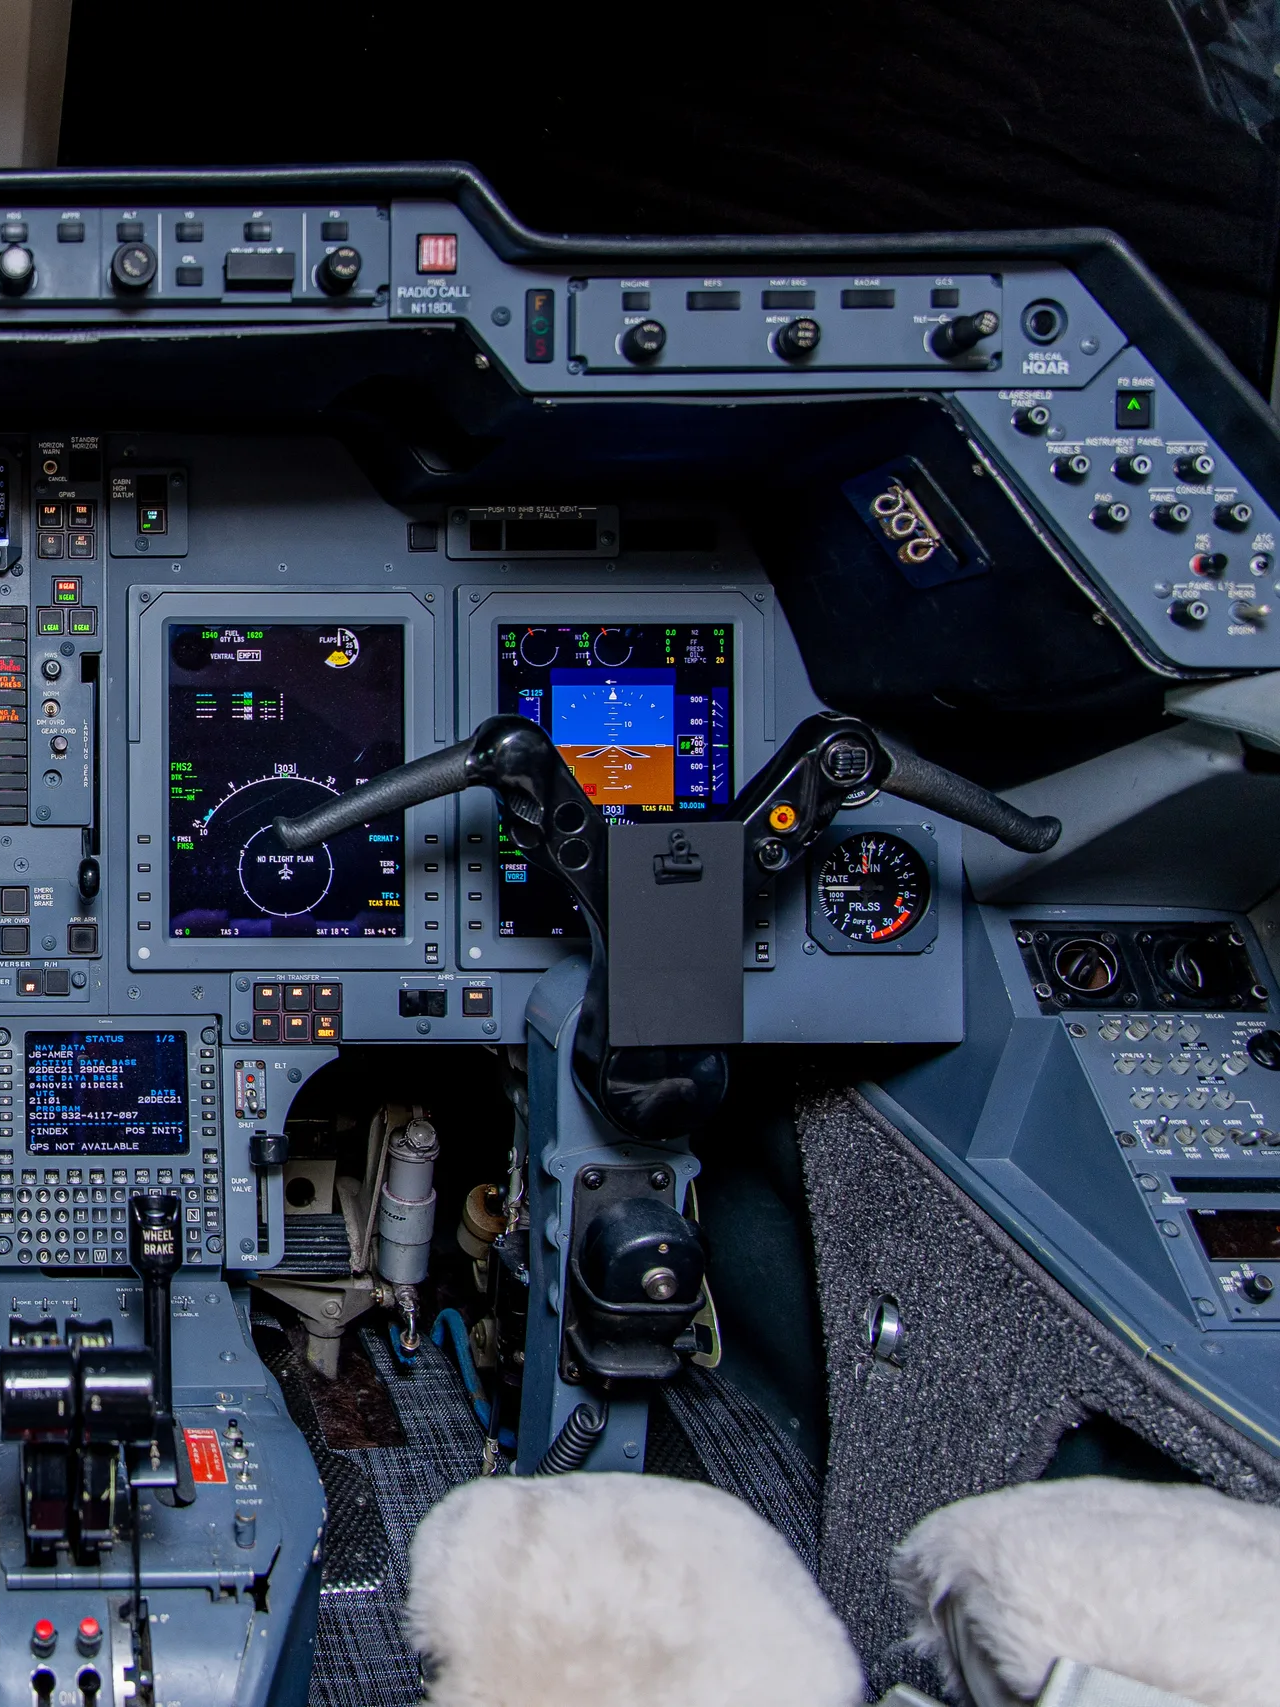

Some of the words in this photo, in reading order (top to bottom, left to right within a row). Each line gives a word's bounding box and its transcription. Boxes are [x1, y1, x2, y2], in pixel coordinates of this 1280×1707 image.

[620, 280, 649, 288] ENGINE
[397, 286, 436, 298] RADIO
[437, 285, 470, 298] CALL
[411, 302, 456, 314] N118DL
[1028, 352, 1062, 361] SELCAL
[1023, 361, 1069, 374] HQAR
[998, 391, 1053, 400] GLARESHIELD
[1085, 437, 1134, 446] INSTRUMENT
[1137, 437, 1164, 446] PANEL
[1048, 446, 1081, 454] PANELS
[1176, 485, 1214, 495] CONSOLE
[202, 631, 218, 639] 1540
[247, 631, 263, 639] 1620
[1227, 626, 1256, 635] STORM
[239, 652, 259, 660] EMPTY
[171, 762, 192, 771] FMS2
[277, 764, 294, 773] 303
[605, 805, 622, 814] 303
[177, 842, 194, 850] FMS2
[257, 855, 266, 863] NO
[269, 855, 294, 863] FLIGHT
[297, 855, 314, 863] PLAN
[826, 875, 848, 883] RATE
[85, 1035, 124, 1043] STATUS
[156, 1035, 175, 1043] 1/2
[36, 1059, 73, 1067] ACTIVE
[80, 1065, 123, 1073] 29DEC21
[36, 1074, 54, 1082] SEC
[29, 1112, 55, 1120] SCID
[30, 1142, 49, 1151] GPS
[81, 1142, 139, 1150] AVAILABLE
[143, 1230, 174, 1241] WHEEL
[144, 1243, 174, 1255] BRAKE
